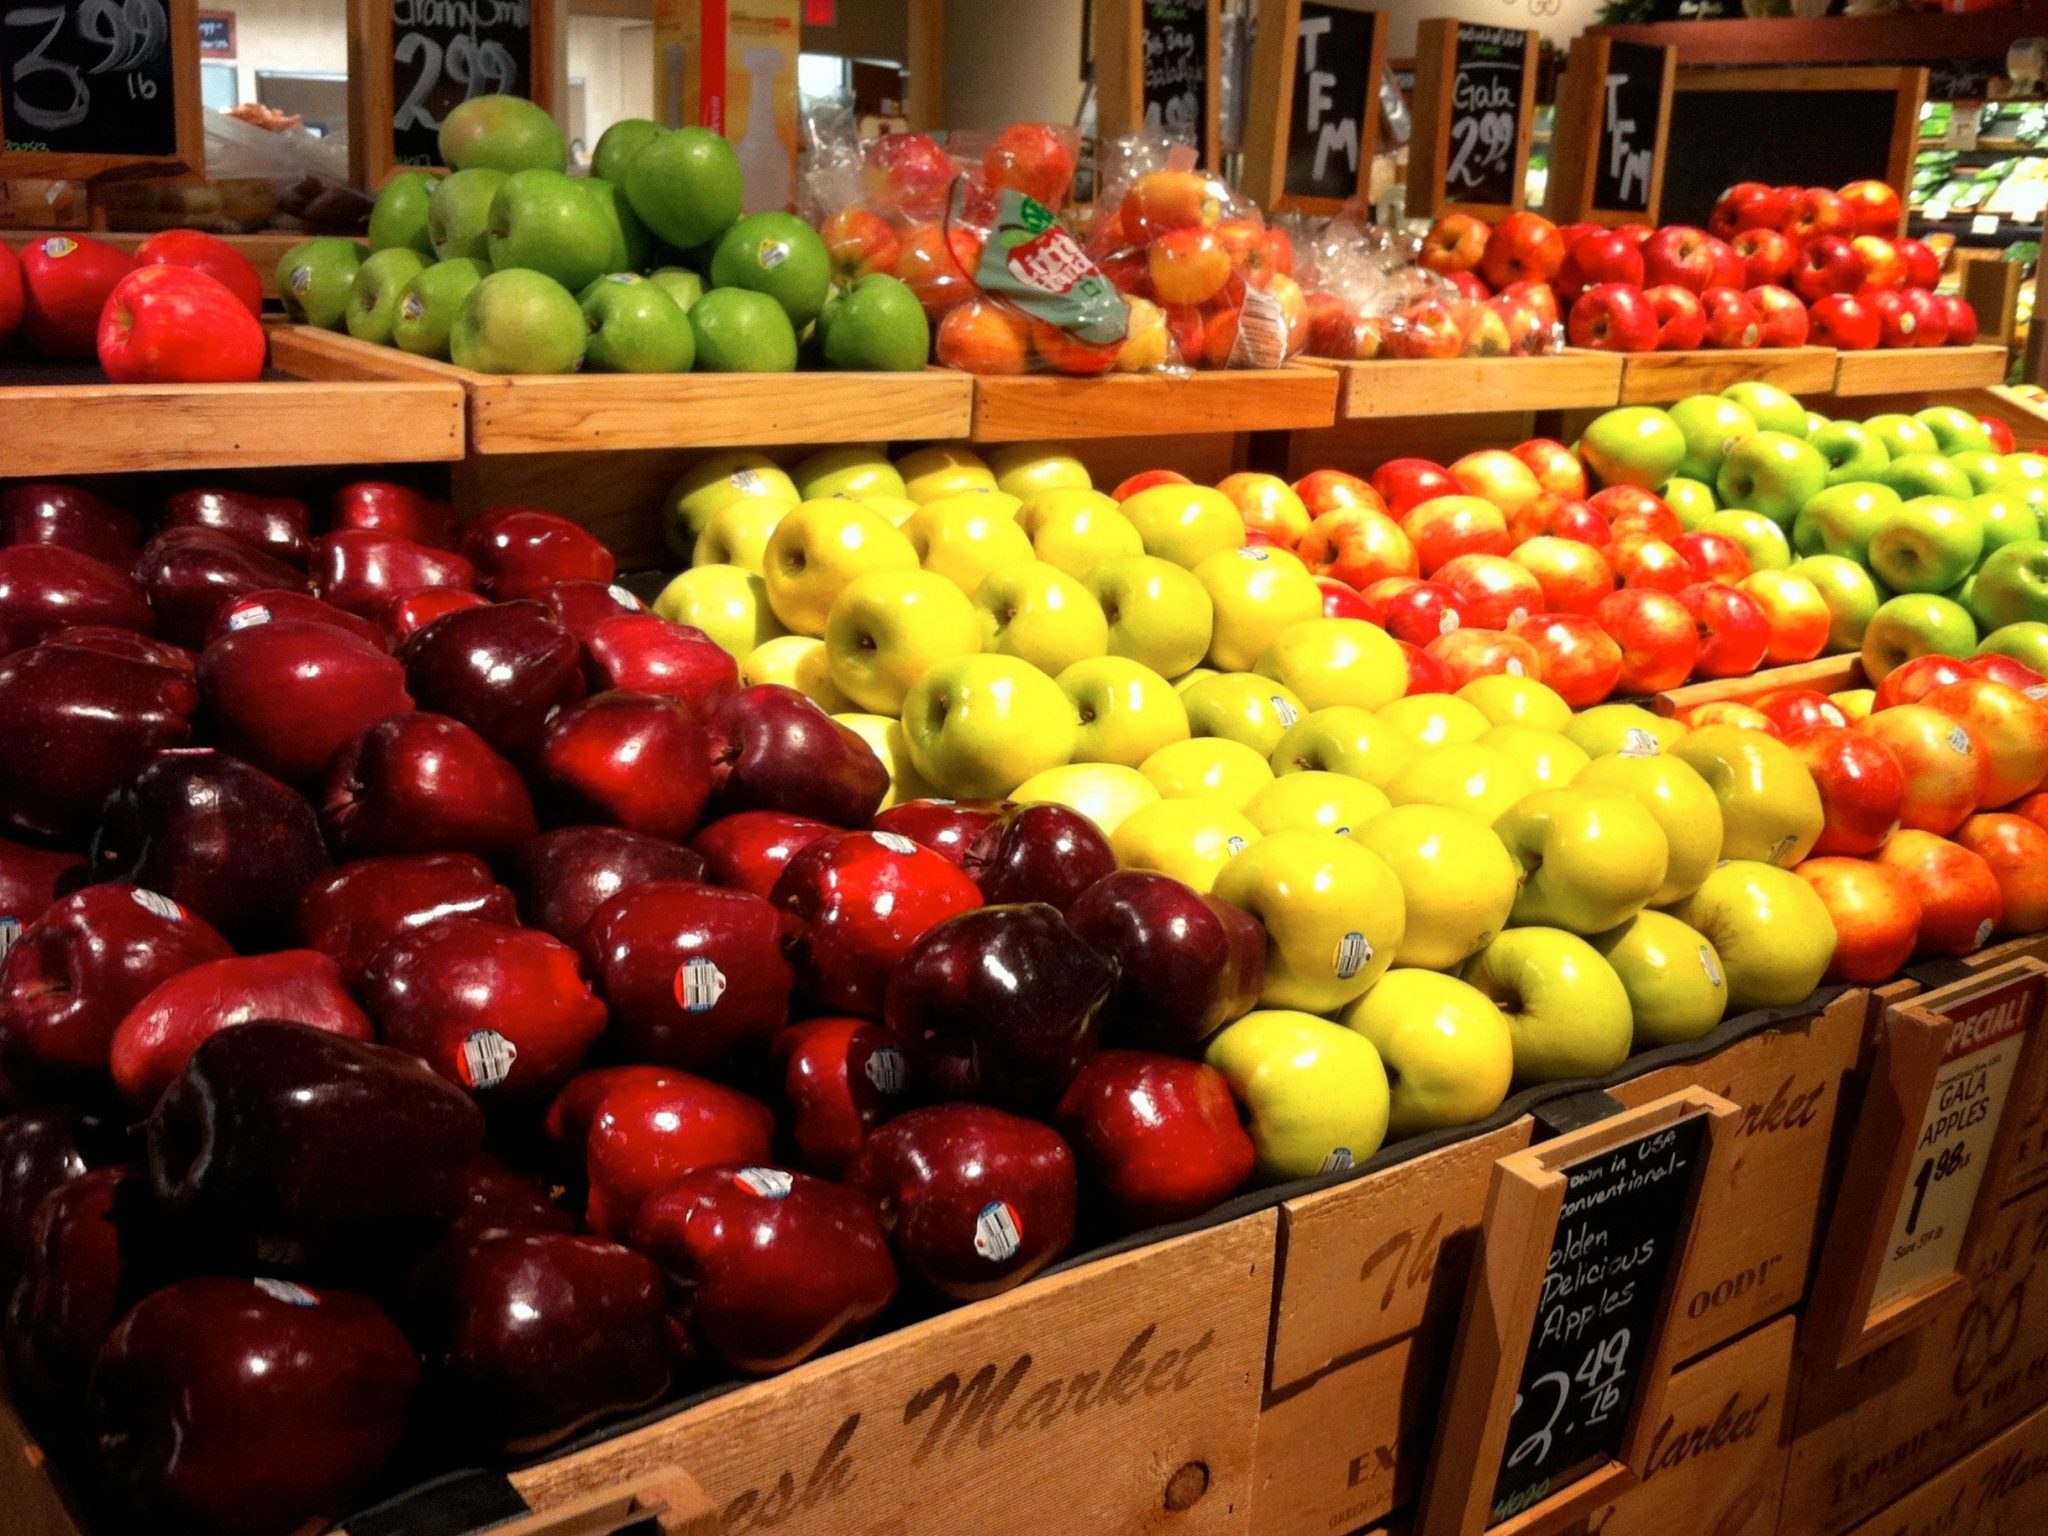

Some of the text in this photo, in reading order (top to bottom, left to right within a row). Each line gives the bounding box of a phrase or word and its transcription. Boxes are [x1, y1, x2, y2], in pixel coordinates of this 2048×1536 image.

[1453, 71, 1516, 112] Gala
[1733, 1073, 1826, 1138] rket
[1938, 1069, 1987, 1112] GALA
[1918, 1095, 1991, 1152] APPLES
[1359, 1210, 1443, 1312] Th
[1540, 1238, 1655, 1314] Delicious
[1547, 1220, 1608, 1271] olden
[1538, 1280, 1636, 1350] Apples
[718, 1322, 1216, 1536] esh Market
